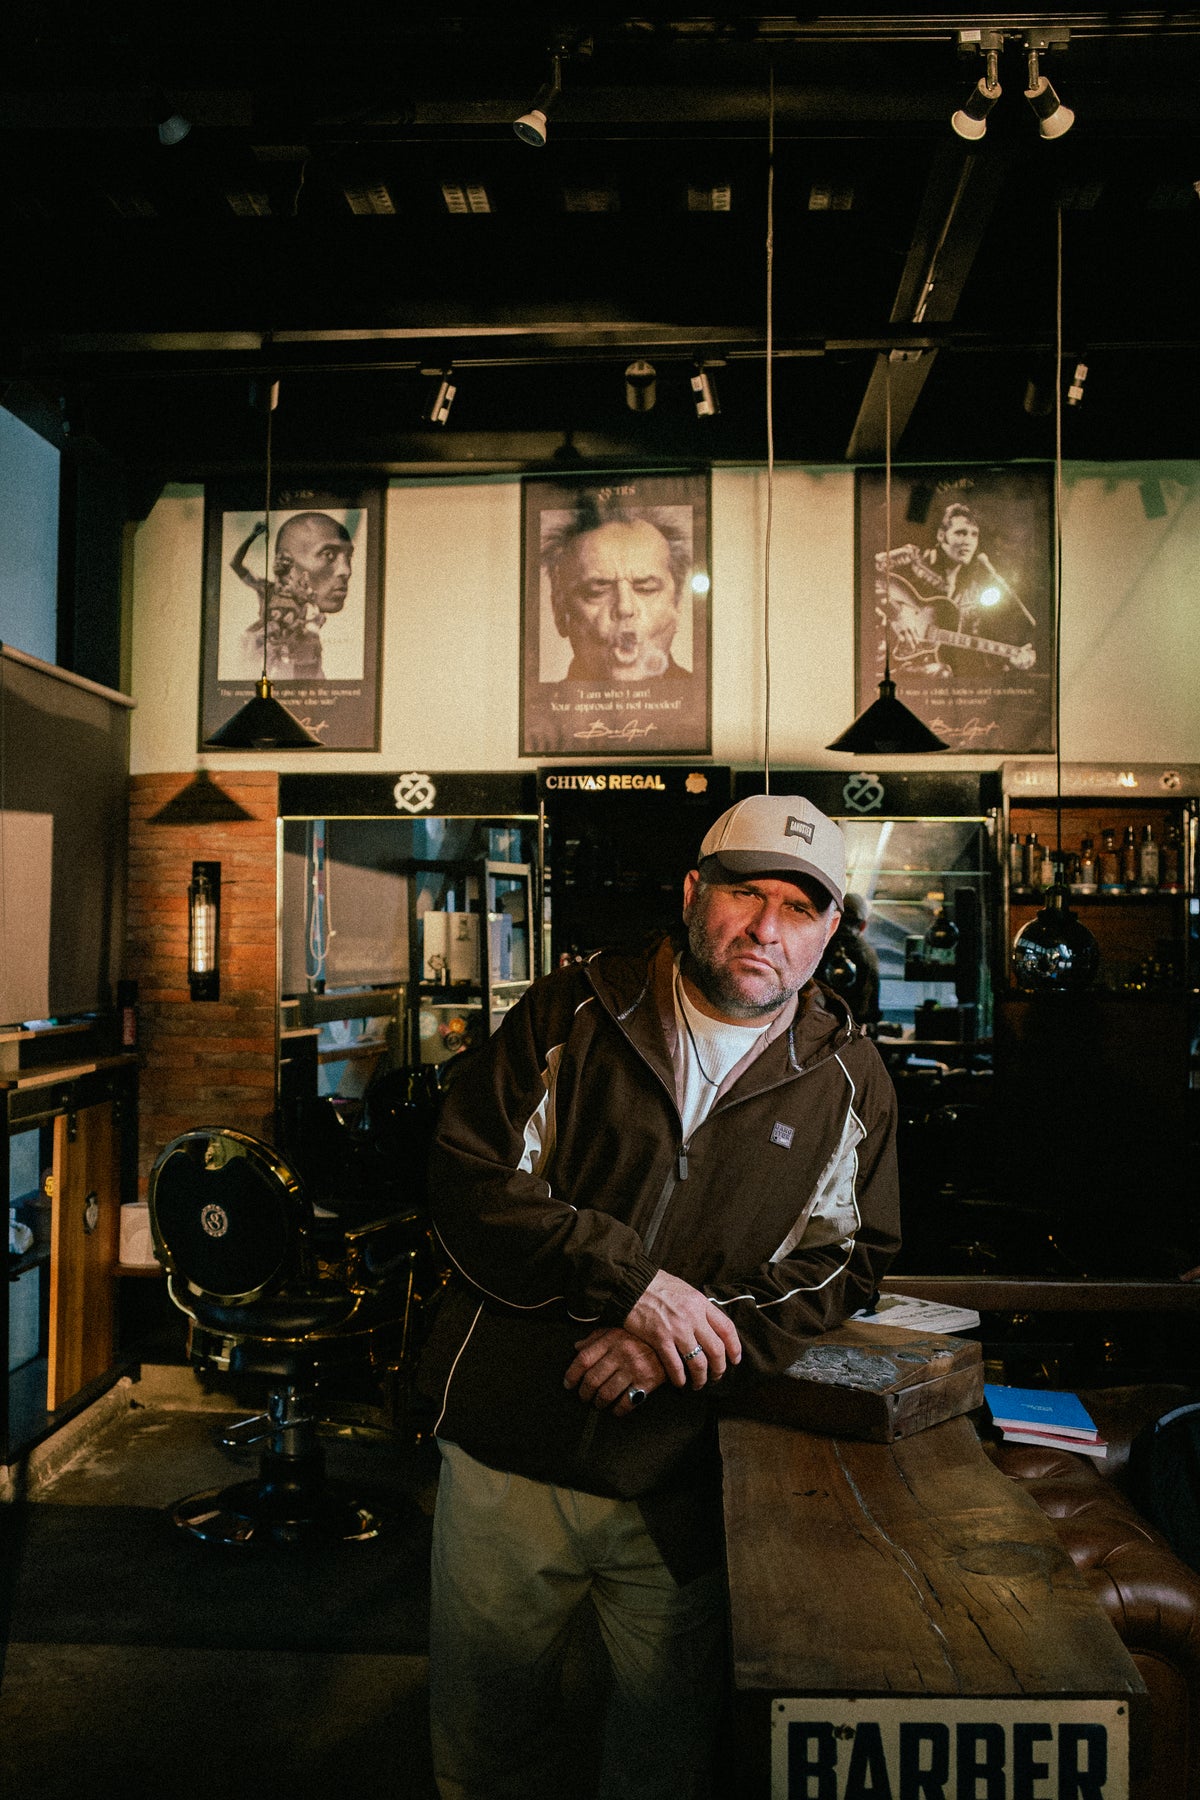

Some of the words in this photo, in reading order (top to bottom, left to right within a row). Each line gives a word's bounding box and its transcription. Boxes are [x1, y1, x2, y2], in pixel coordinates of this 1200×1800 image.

[604, 689, 624, 698] who
[550, 701, 570, 711] Your
[574, 701, 613, 713] approval
[615, 701, 624, 710] is
[626, 700, 641, 710] not
[546, 775, 607, 790] CHIVAS
[608, 775, 666, 791] REGAL
[788, 1721, 1107, 1800] BARBER
